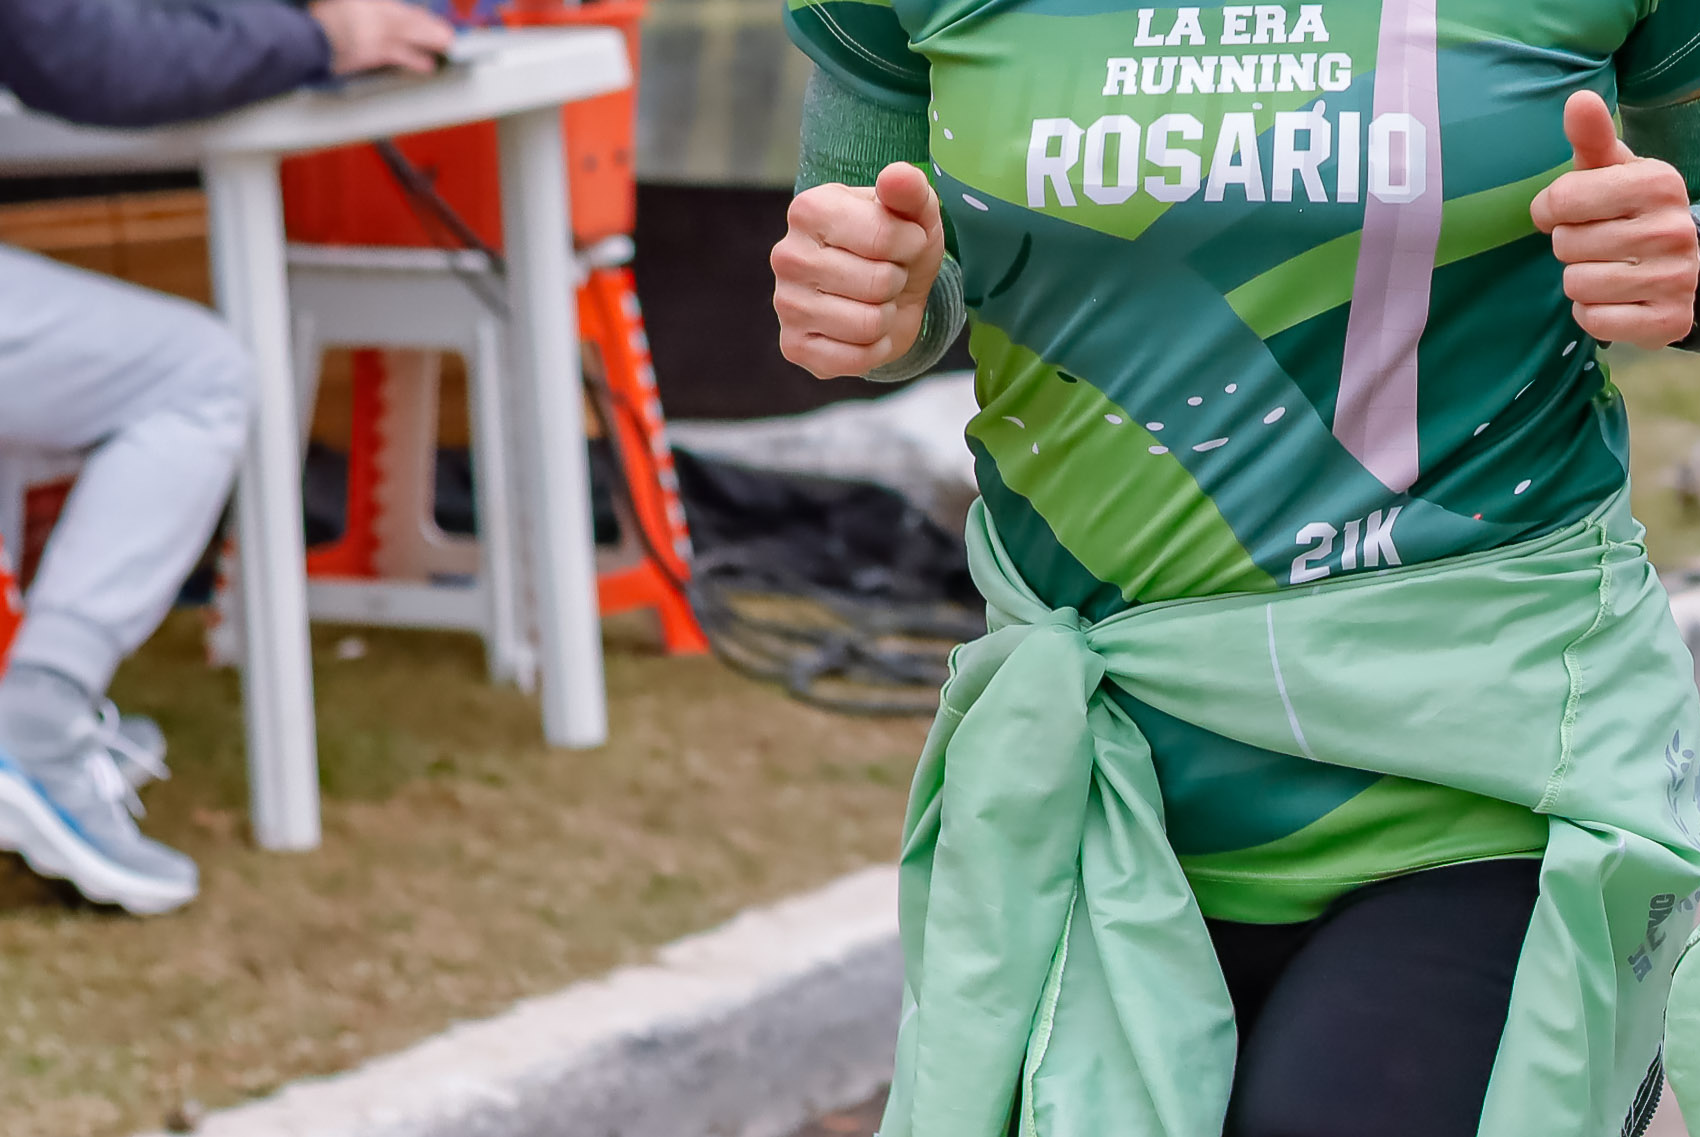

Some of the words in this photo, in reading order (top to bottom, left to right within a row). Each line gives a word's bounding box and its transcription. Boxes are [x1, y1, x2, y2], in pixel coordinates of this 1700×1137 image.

[1133, 7, 1206, 47] LA
[1220, 4, 1330, 45] ERA
[1102, 52, 1353, 96] RUNNING
[1026, 110, 1427, 208] ROSARIO
[1289, 505, 1404, 585] 21K
